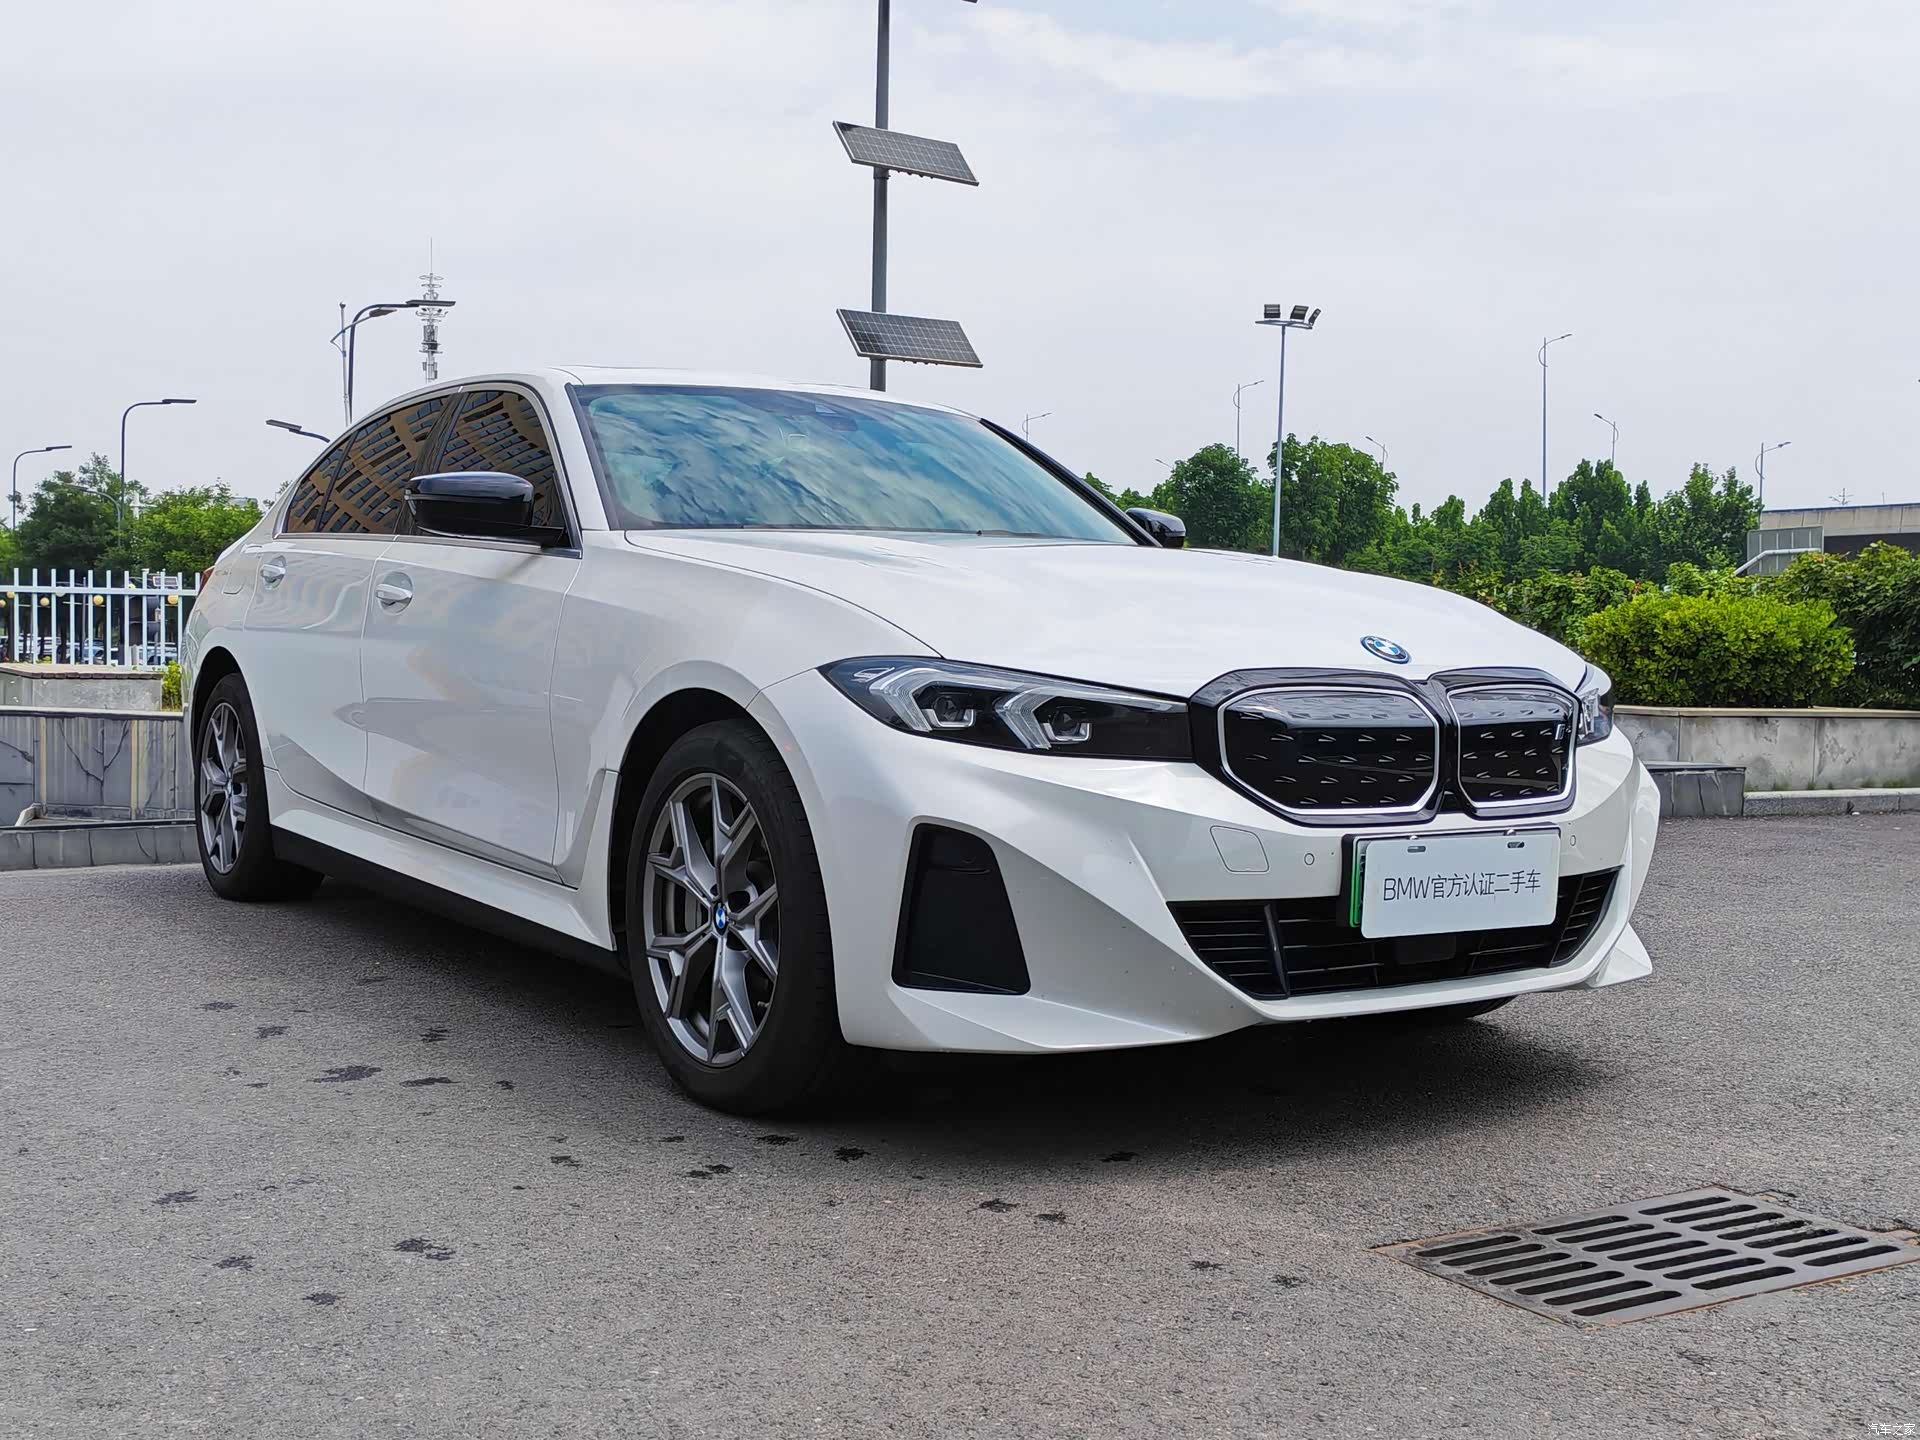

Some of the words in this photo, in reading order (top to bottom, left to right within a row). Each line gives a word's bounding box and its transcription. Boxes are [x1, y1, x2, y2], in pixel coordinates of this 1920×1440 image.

[1383, 869, 1541, 901] BMW官方认证二手车
